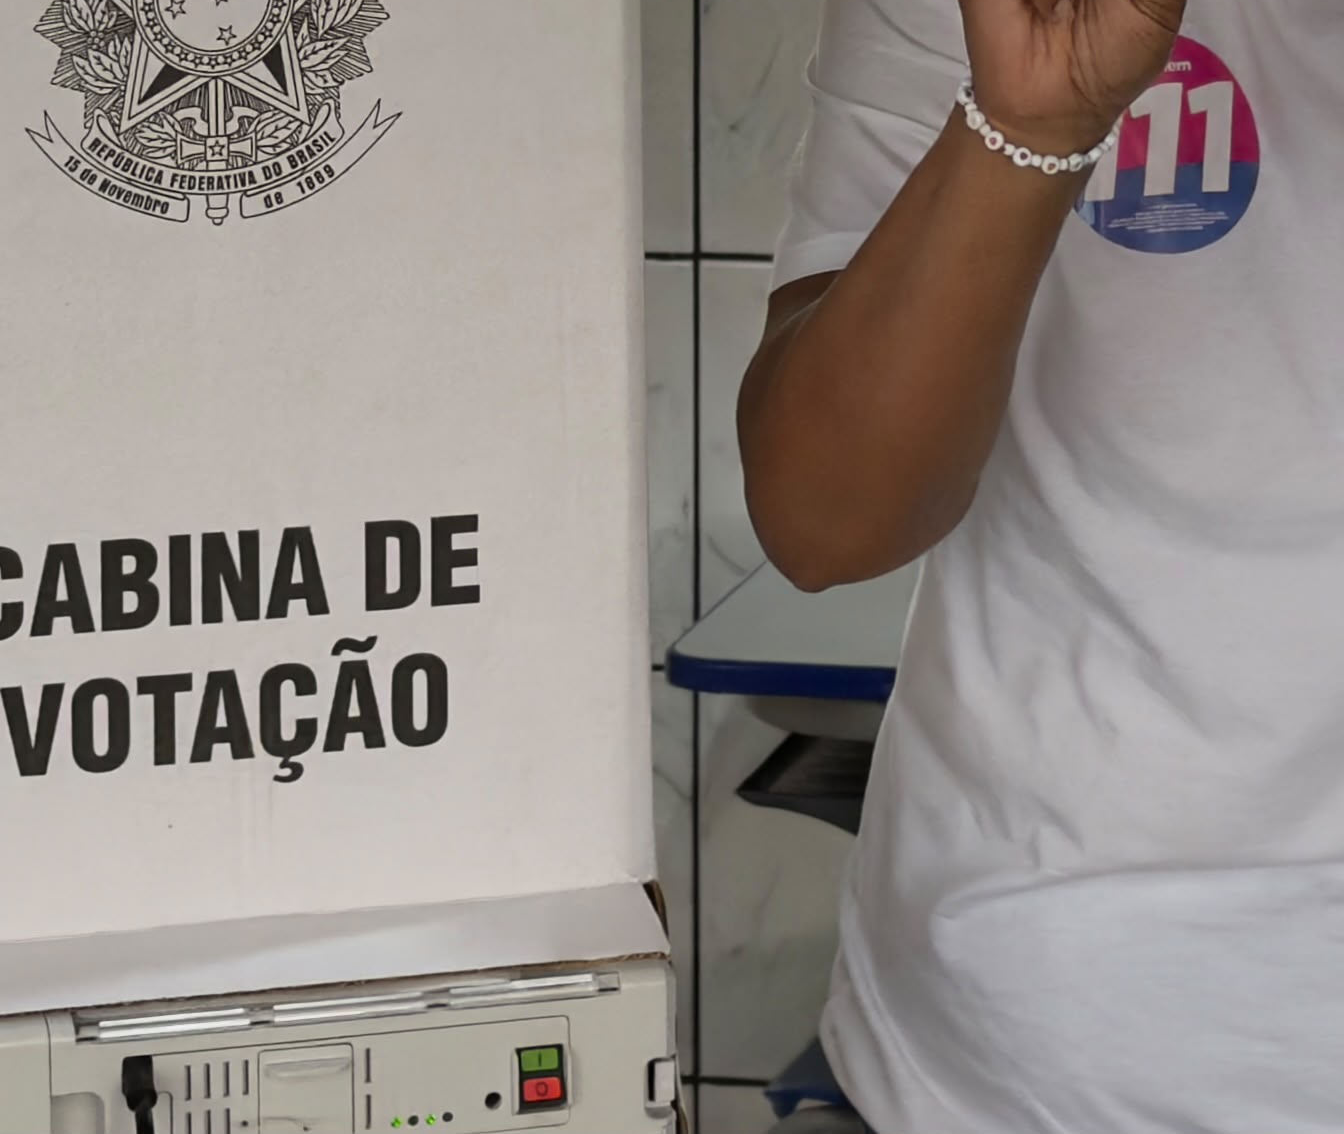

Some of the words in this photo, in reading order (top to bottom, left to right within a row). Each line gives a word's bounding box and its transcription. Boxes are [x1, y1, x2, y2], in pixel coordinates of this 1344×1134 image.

[64, 155, 81, 173] 15
[79, 168, 98, 185] de
[98, 177, 170, 215] Novembro
[264, 191, 284, 209] de
[297, 164, 336, 195] 1889
[88, 137, 164, 185] REPÚBLICA
[170, 170, 257, 191] FEDERATIVA
[262, 162, 283, 181] DO
[286, 131, 337, 169] BRASIL
[364, 514, 481, 612] DE
[0, 635, 448, 783] VOTAÇÃO
